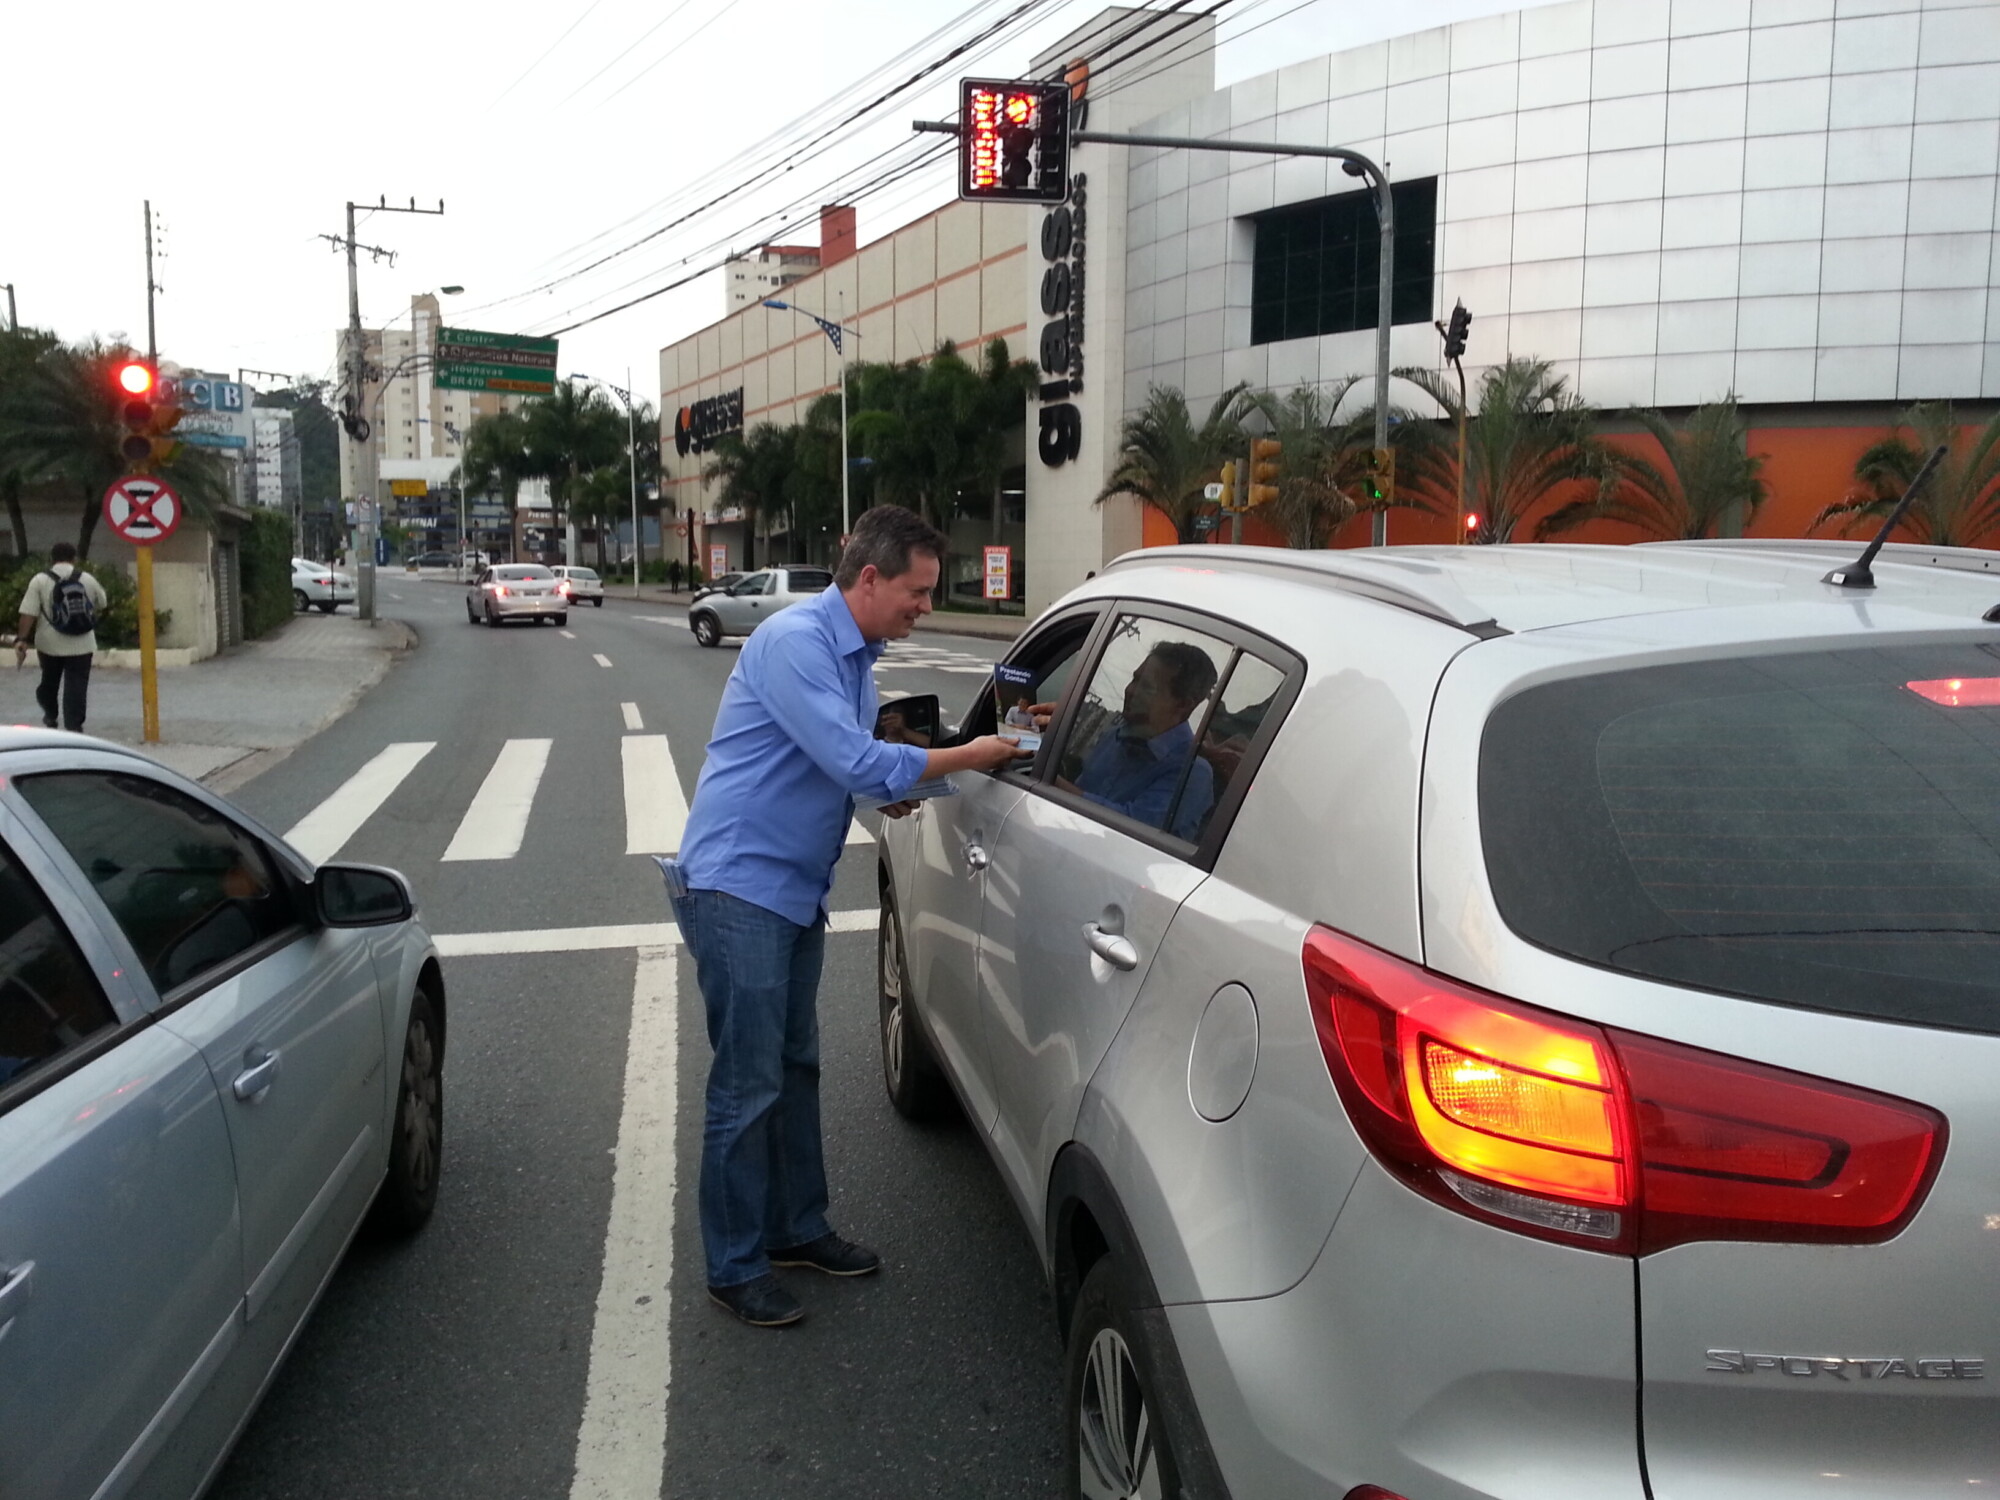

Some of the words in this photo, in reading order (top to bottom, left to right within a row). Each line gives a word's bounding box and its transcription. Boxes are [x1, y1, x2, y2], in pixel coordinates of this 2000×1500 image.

[1038, 180, 1082, 467] giass
[511, 353, 552, 366] Naturais
[450, 376, 466, 386] BR
[467, 376, 485, 388] 470
[999, 665, 1032, 679] Prestando
[1004, 673, 1028, 685] Contas
[1704, 1348, 1986, 1382] SPORTAGE
